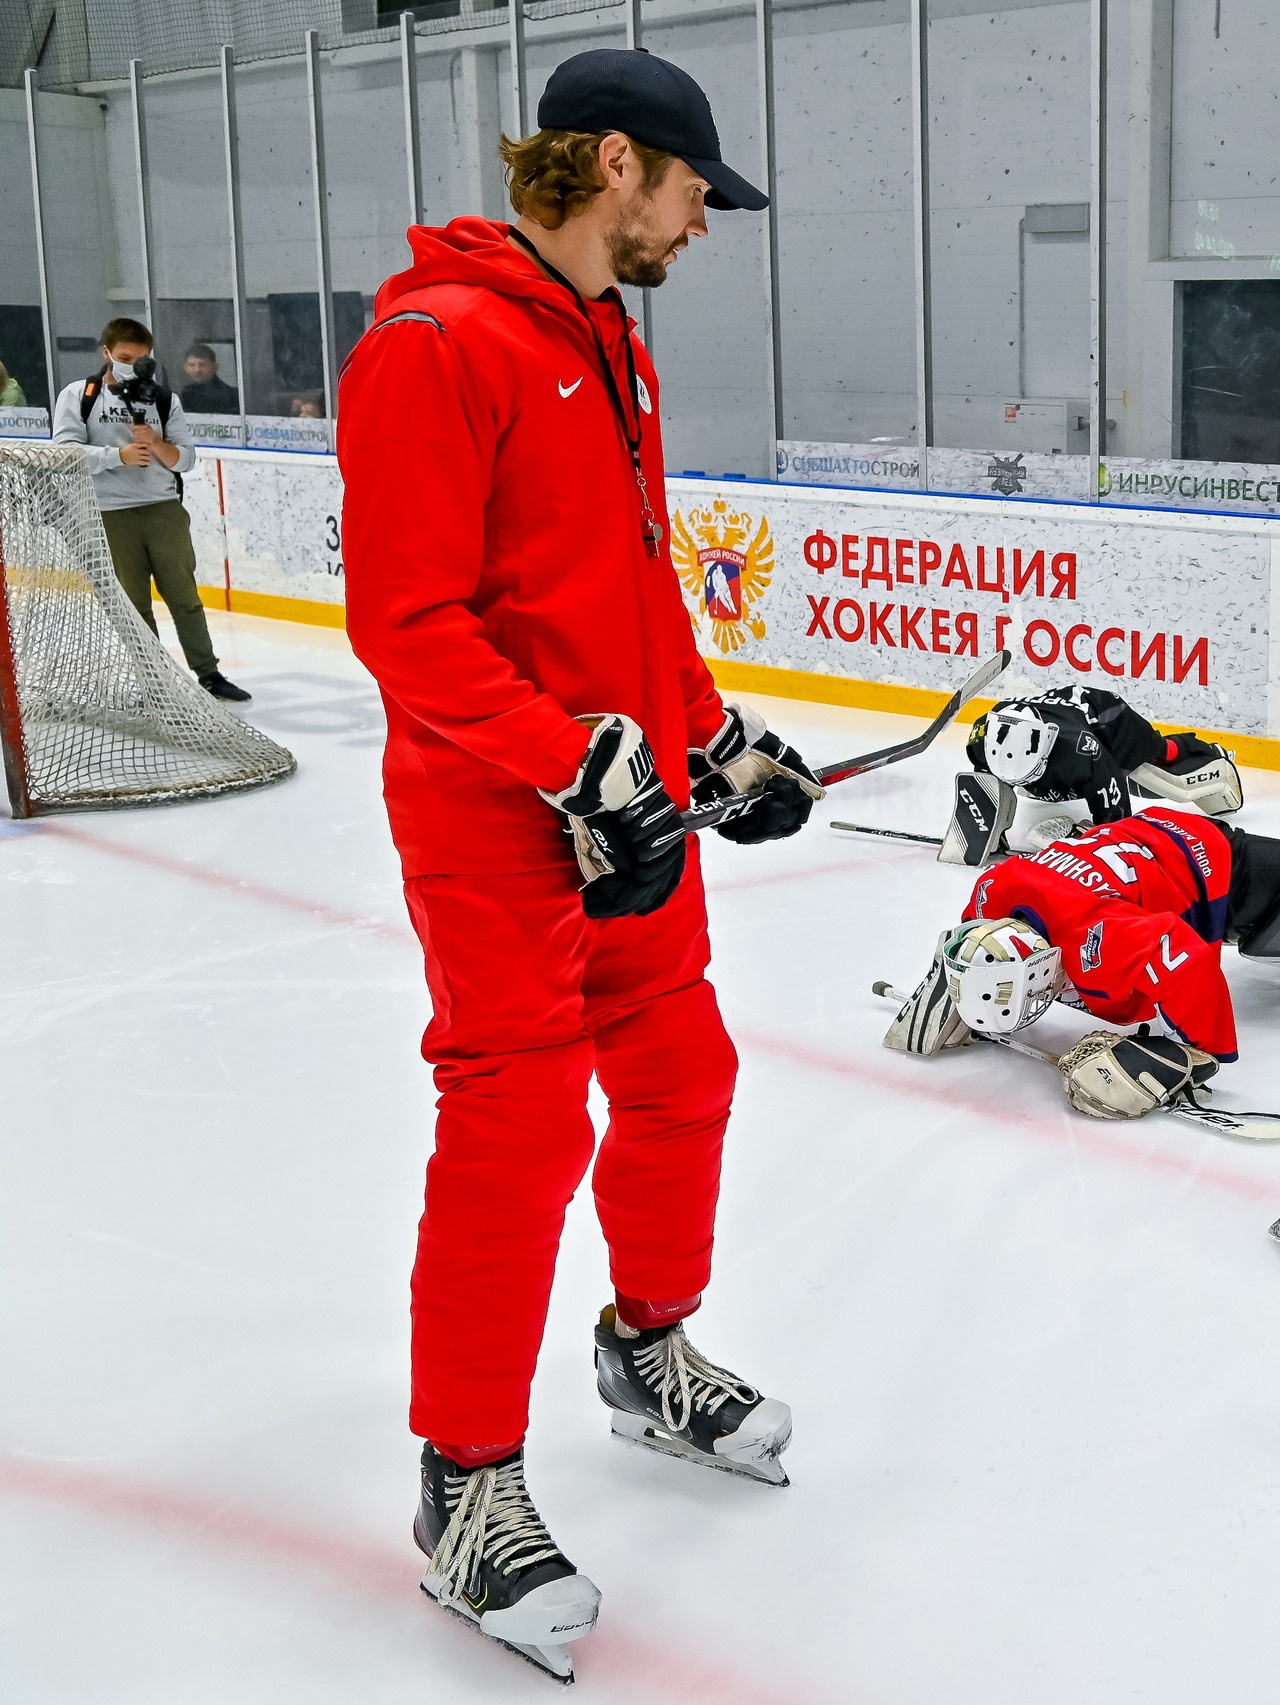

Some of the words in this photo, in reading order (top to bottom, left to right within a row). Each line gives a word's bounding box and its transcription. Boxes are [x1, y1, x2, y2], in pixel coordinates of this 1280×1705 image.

[792, 456, 920, 478] СИБШАХТОСТРОЙ
[804, 529, 1077, 603] ФЕДЕРАЦИЯ
[805, 595, 979, 658] ХОККЕЯ
[1186, 770, 1221, 786] CCM
[689, 798, 724, 815] CCM
[959, 788, 989, 832] CCM
[1191, 840, 1212, 878] ФОНД
